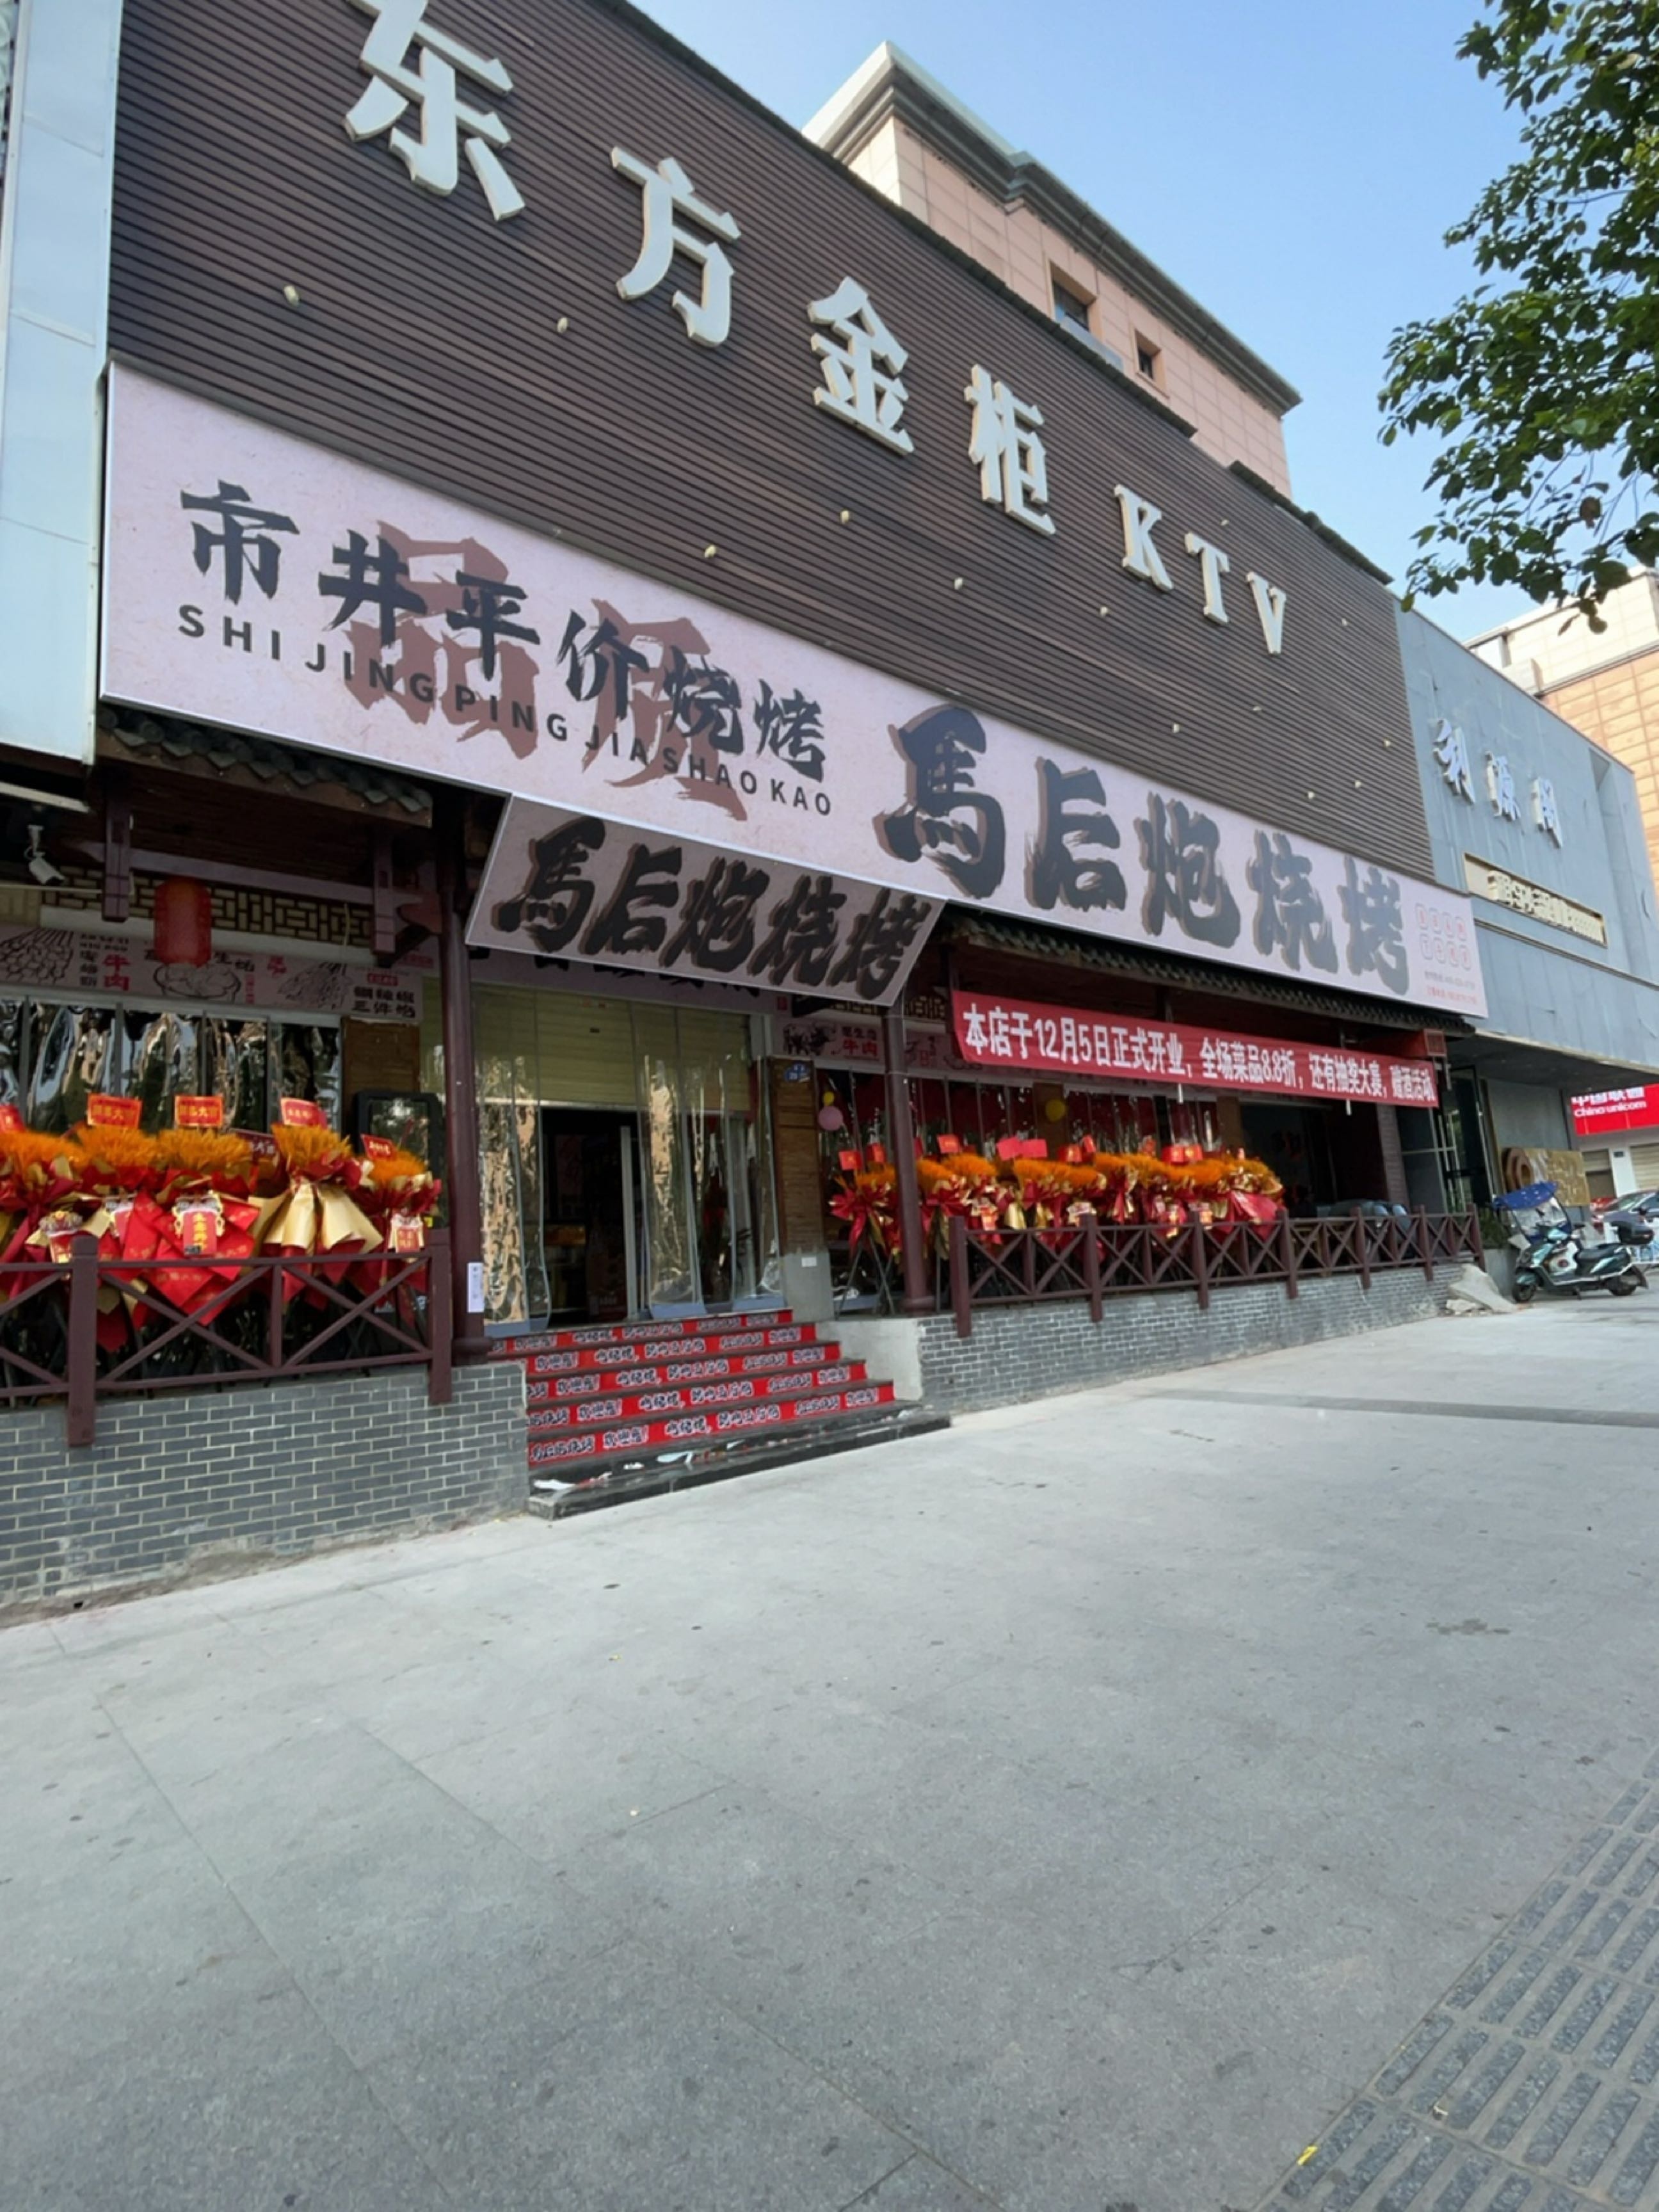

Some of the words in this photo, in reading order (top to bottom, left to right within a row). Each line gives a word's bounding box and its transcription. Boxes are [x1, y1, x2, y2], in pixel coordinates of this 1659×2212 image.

[180, 479, 826, 782] 市井平价烧烤
